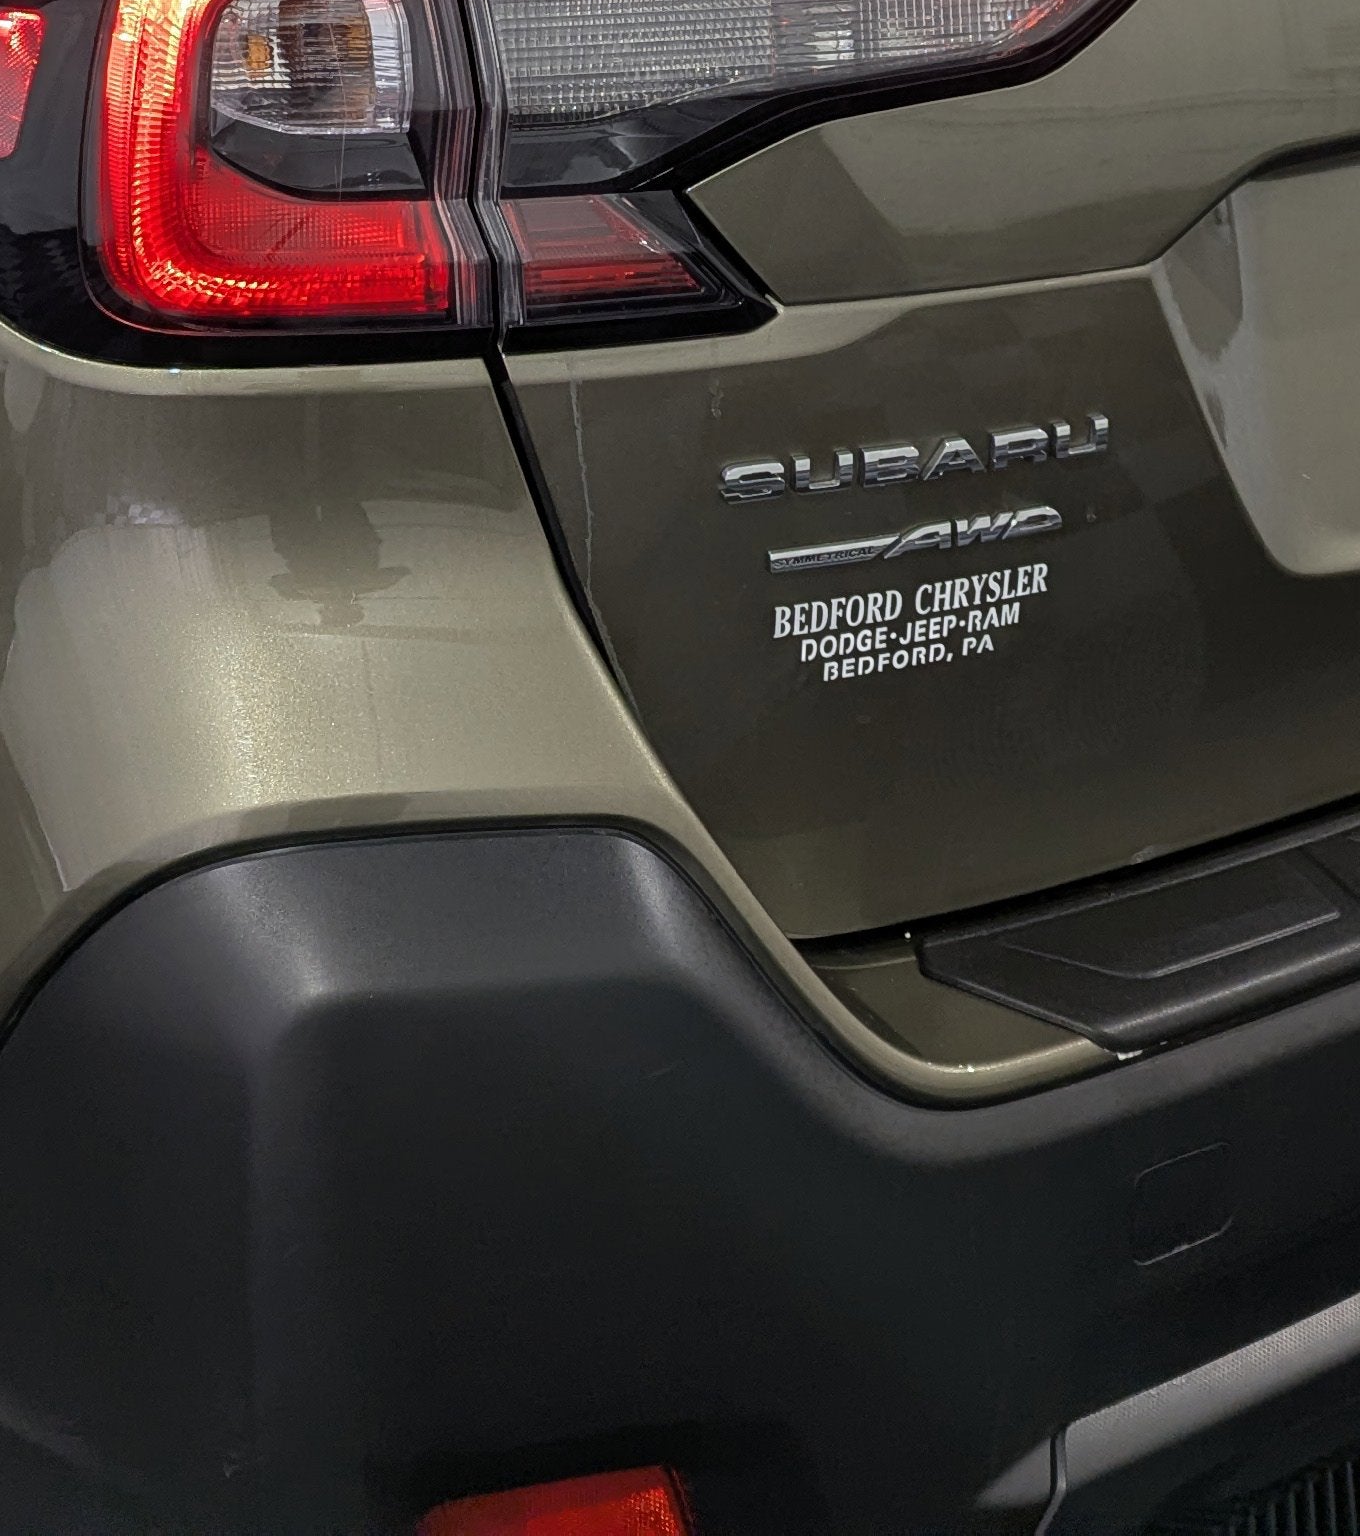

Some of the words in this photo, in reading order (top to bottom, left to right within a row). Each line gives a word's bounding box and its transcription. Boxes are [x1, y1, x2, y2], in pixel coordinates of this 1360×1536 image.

[718, 412, 1110, 505] SUBARU
[771, 544, 878, 570] SYMMETRICAL
[883, 504, 1064, 560] AWD
[772, 589, 904, 639] BEDFORD
[914, 563, 1049, 613] CHRYSLER
[822, 642, 954, 683] BEDFORD,
[961, 632, 995, 657] PA
